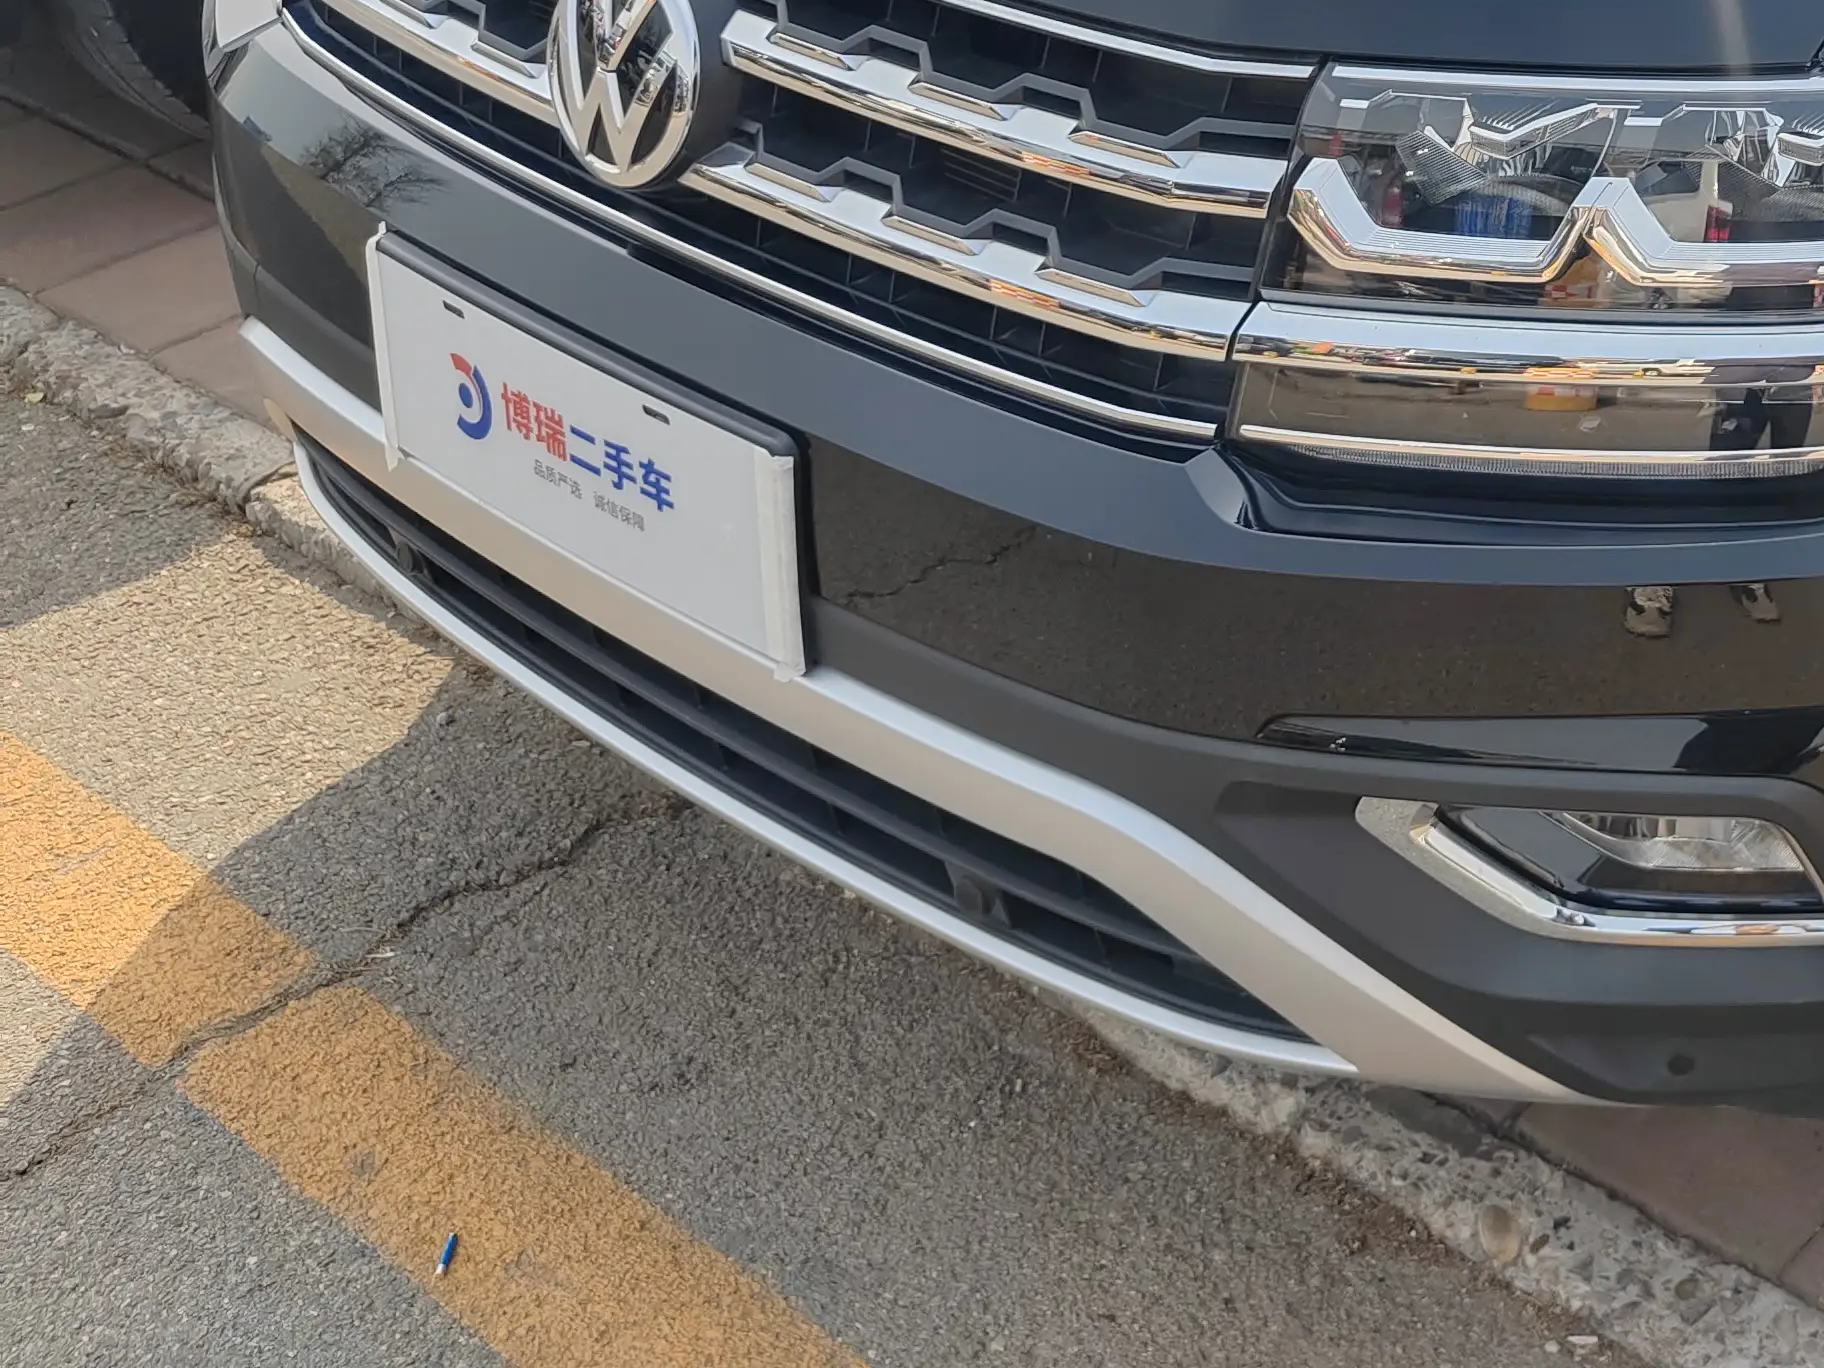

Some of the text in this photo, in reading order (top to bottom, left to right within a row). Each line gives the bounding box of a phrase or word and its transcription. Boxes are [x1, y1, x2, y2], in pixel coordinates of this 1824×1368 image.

[500, 381, 675, 512] 博瑞二手车
